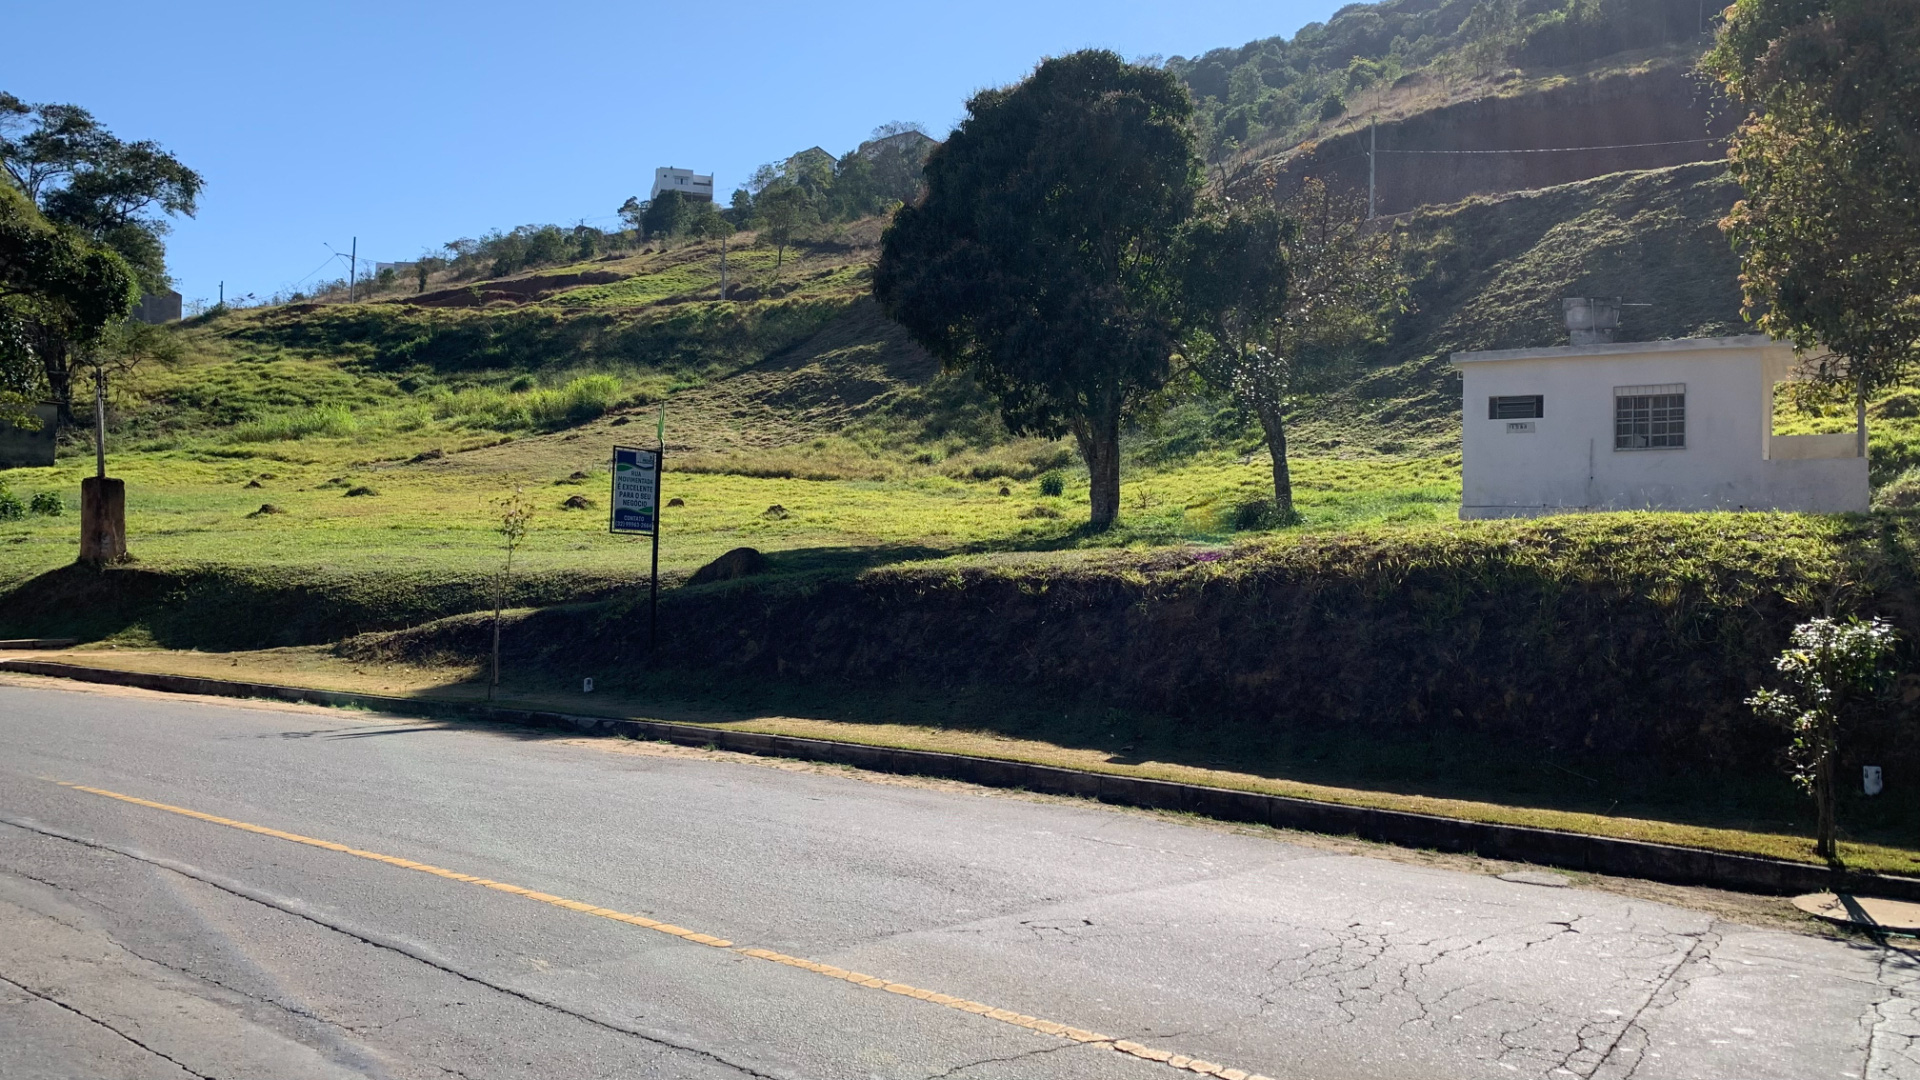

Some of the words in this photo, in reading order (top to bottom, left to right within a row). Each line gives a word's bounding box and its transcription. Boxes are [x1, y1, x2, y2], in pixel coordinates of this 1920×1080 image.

[618, 476, 653, 484] MOVIMENTADA
[618, 482, 621, 490] É
[622, 483, 653, 492] EXCELENTE
[623, 499, 647, 507] NEGÓCIO
